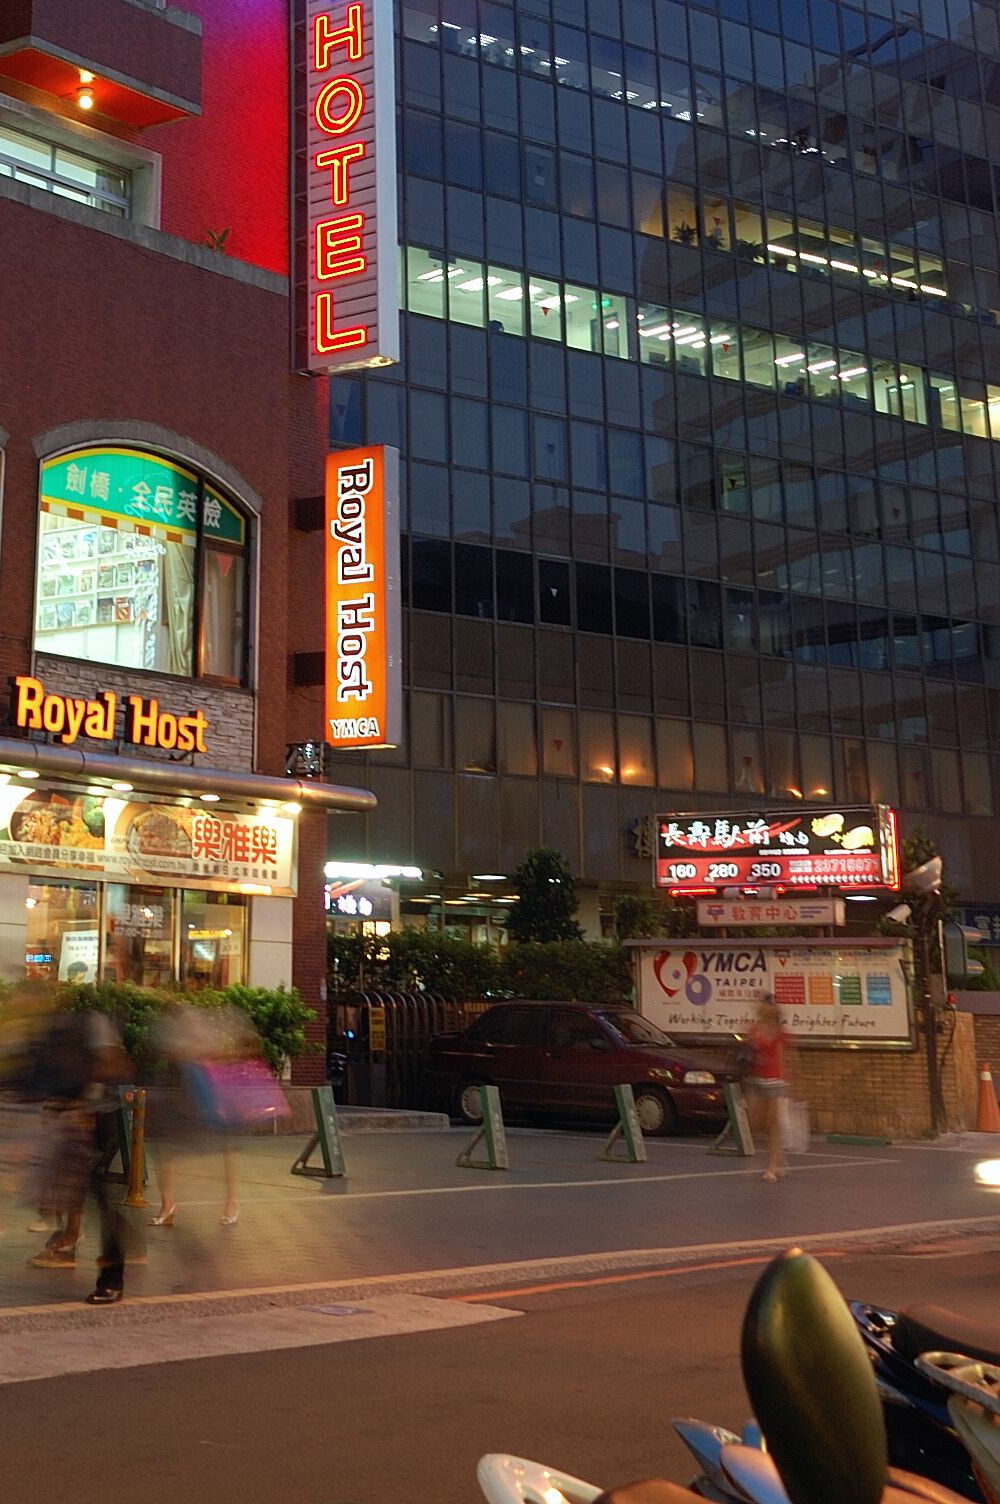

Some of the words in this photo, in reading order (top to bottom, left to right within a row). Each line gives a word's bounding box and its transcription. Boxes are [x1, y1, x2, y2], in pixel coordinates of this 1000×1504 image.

[312, 3, 367, 354] HOTEL
[330, 458, 374, 585] Royal
[336, 592, 375, 703] Host
[14, 675, 118, 745] Royal
[126, 695, 209, 754] Host
[330, 715, 379, 739] YMCA
[192, 816, 278, 865] 樂雅樂
[751, 863, 781, 878] 350
[732, 904, 798, 921] 教育中心
[701, 951, 767, 973] YMCA
[715, 977, 763, 987] TAIPEI
[668, 1013, 713, 1030] Working
[792, 1013, 838, 1031] Brighter
[840, 1014, 876, 1028] Future
